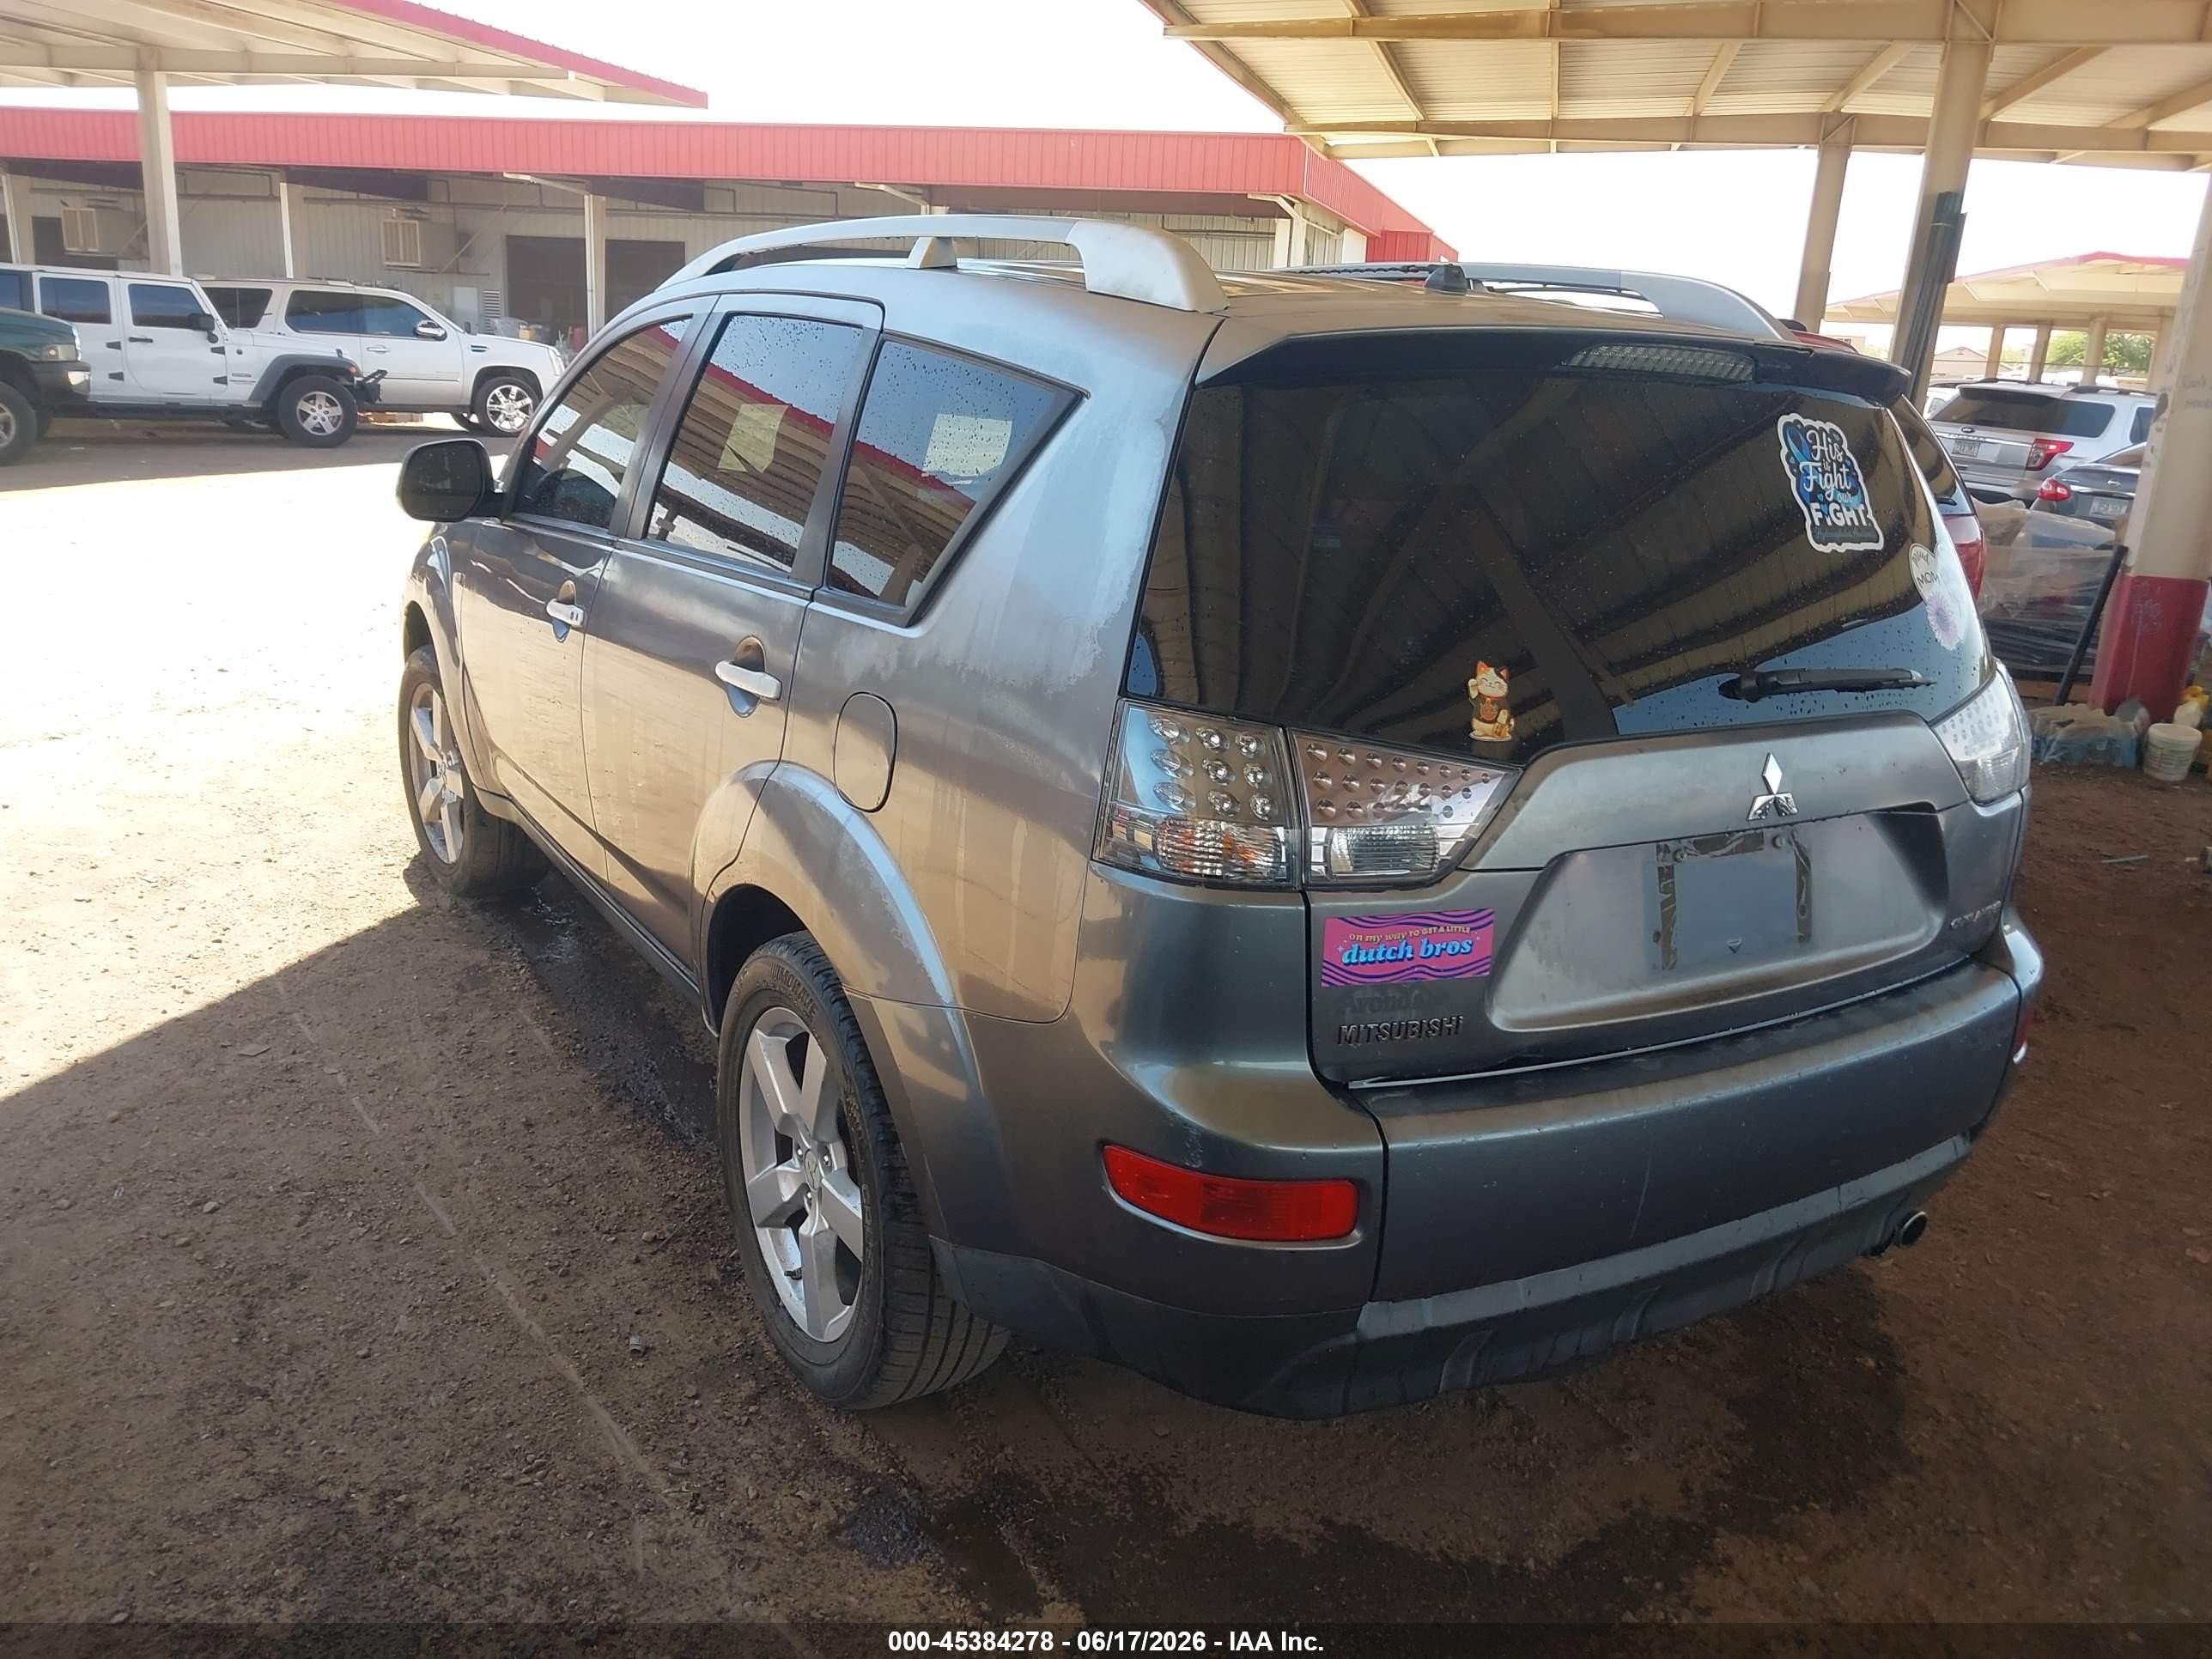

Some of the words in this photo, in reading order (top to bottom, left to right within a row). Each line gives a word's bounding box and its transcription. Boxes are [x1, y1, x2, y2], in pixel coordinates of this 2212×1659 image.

[1806, 429, 1844, 462] His
[1823, 459, 1831, 472] is
[1799, 461, 1851, 501] Fight
[1837, 491, 1855, 502] our
[1365, 934, 1383, 944] my
[1385, 932, 1407, 941] way
[1421, 927, 1438, 935] GET
[1341, 939, 1413, 965] dutch
[1419, 937, 1474, 959] bros
[1337, 1015, 1463, 1045] MITSUBISHI
